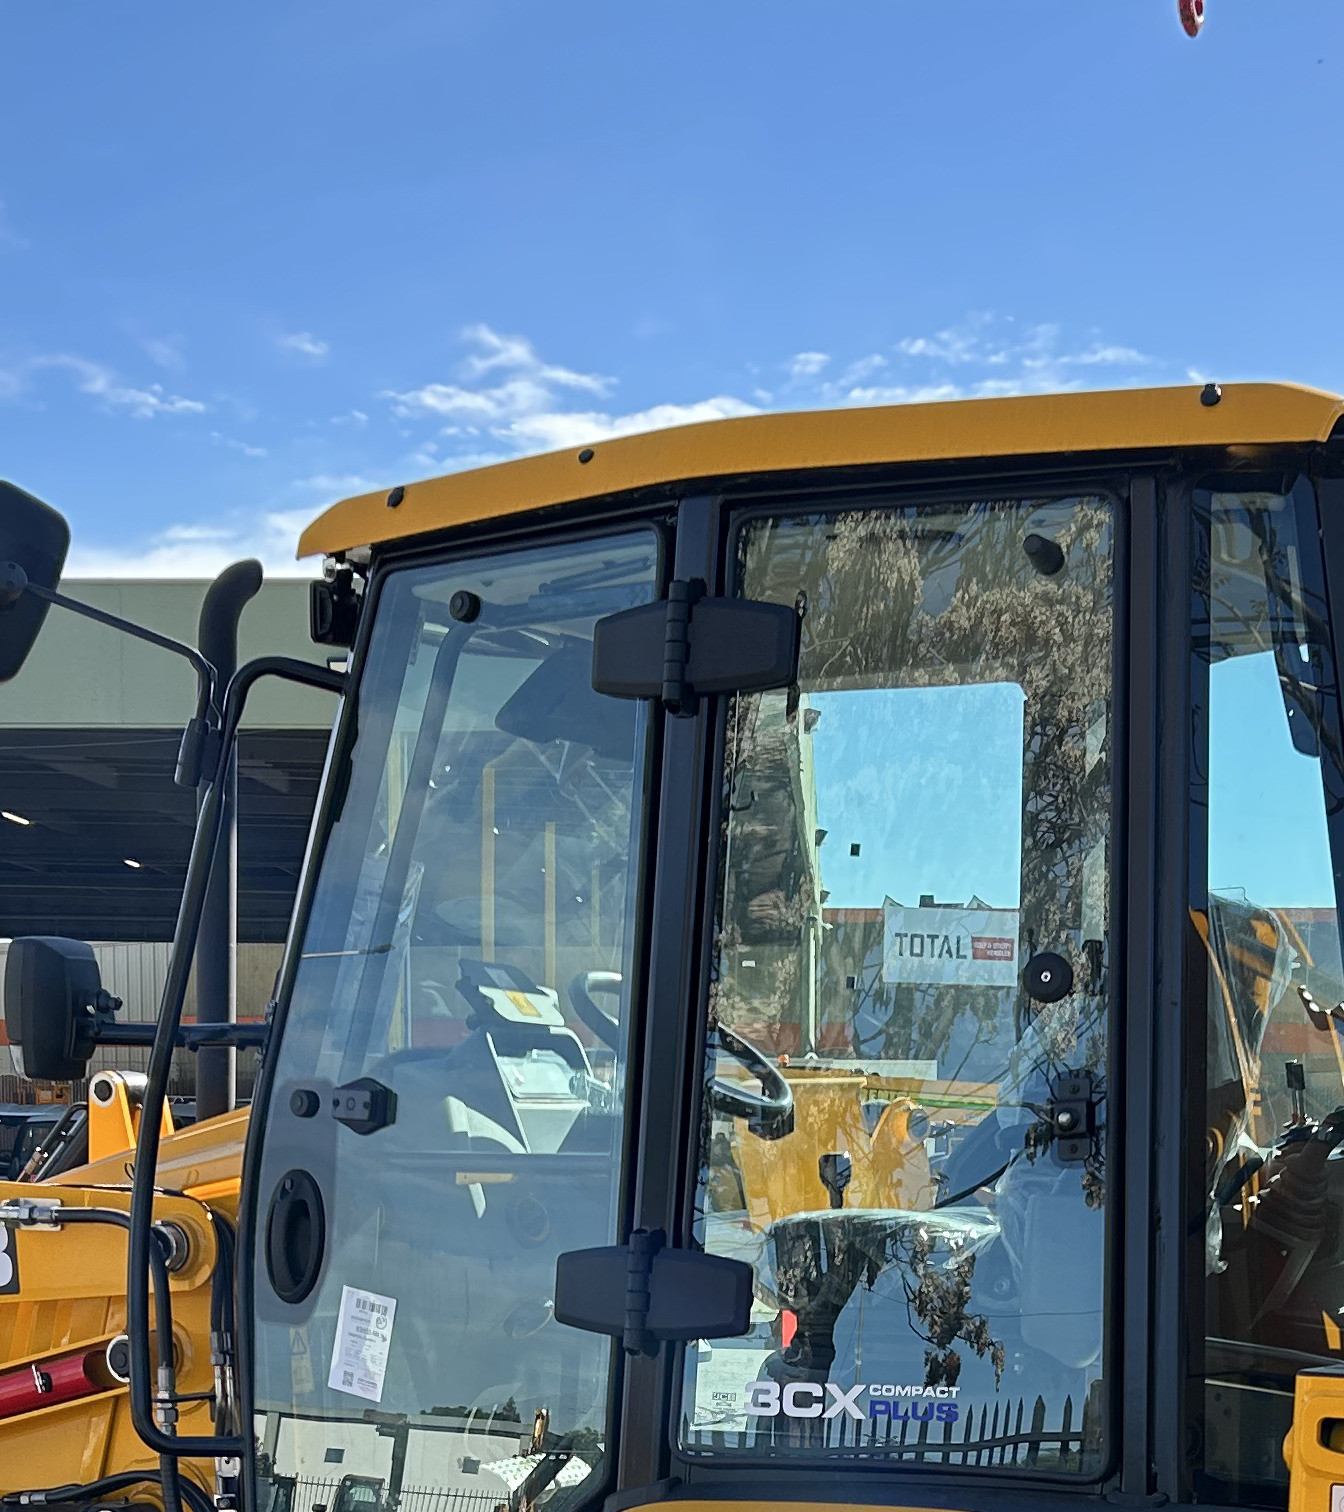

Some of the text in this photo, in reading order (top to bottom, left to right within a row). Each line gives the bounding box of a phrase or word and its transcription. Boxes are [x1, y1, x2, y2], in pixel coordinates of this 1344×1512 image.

[895, 933, 967, 959] TOTAL
[713, 1392, 736, 1401] JCB
[744, 1381, 866, 1420] 3CX
[869, 1383, 961, 1399] COMPACT
[869, 1400, 960, 1424] PLUS
